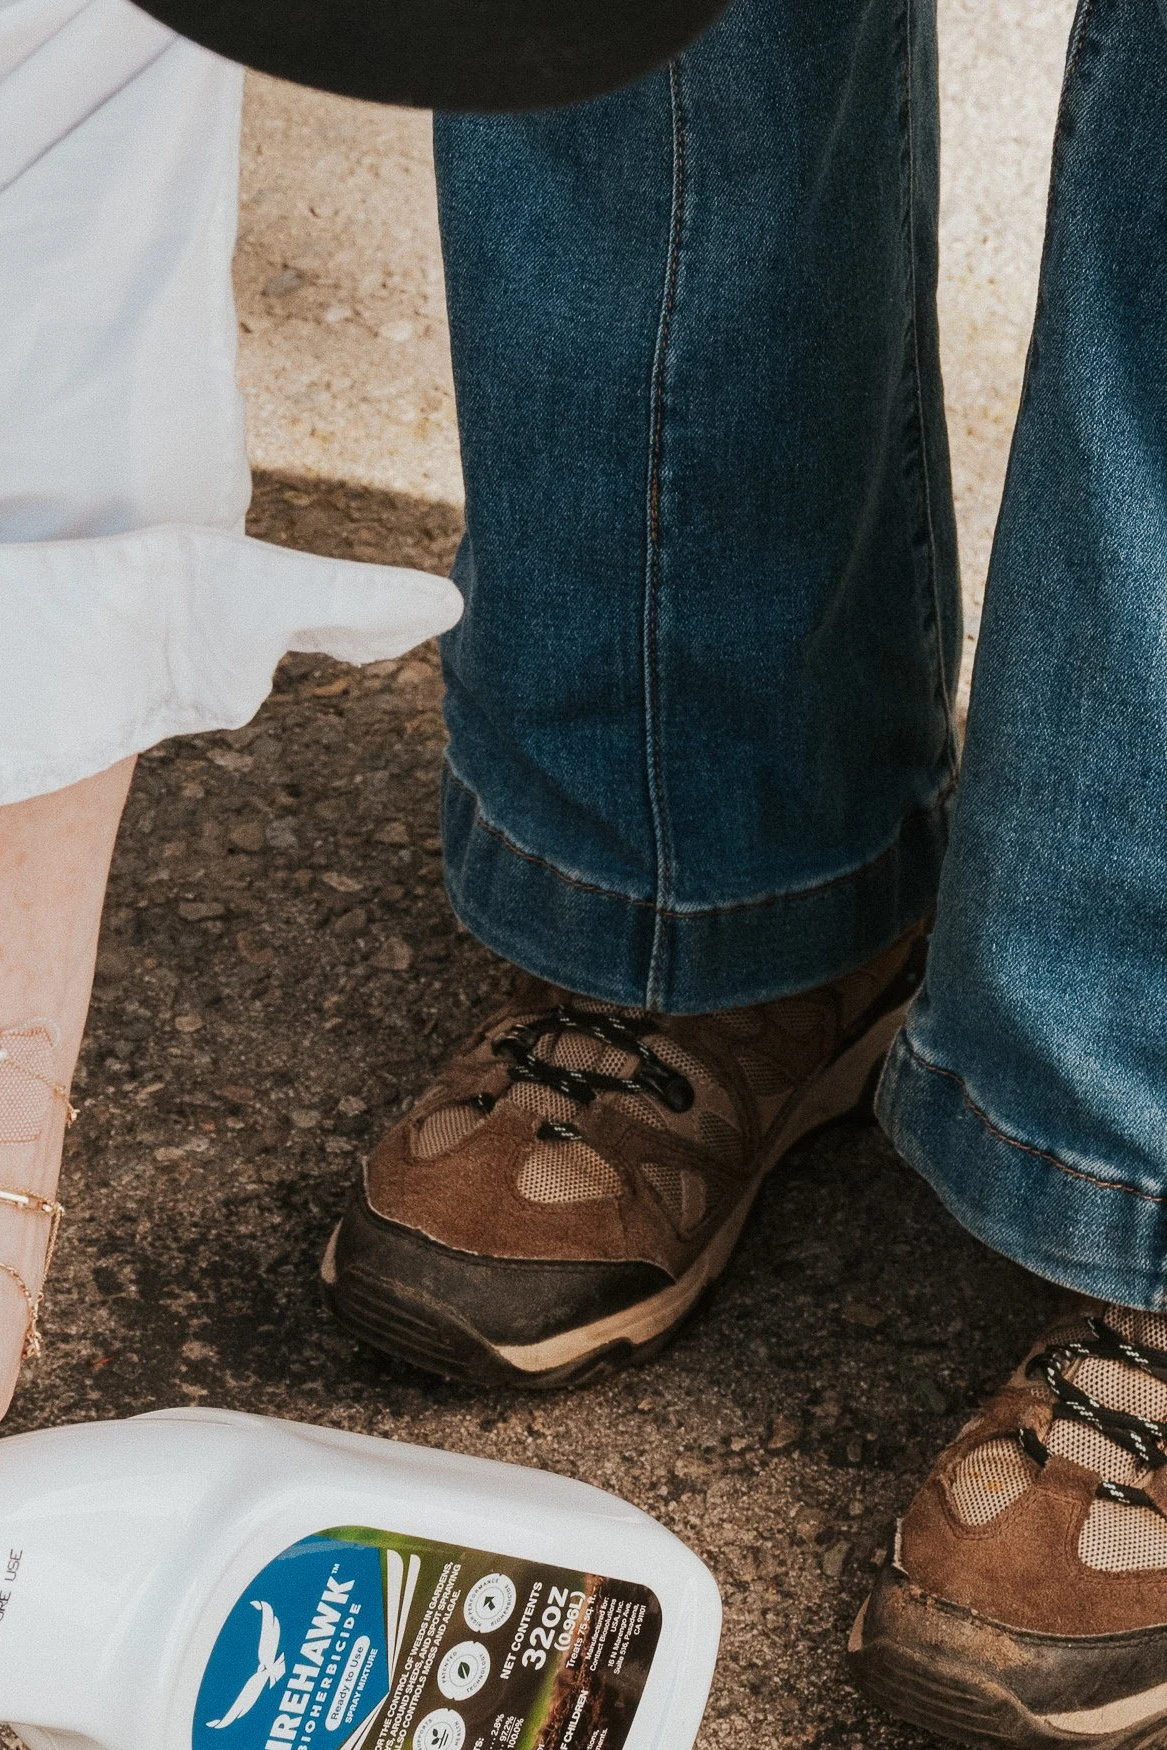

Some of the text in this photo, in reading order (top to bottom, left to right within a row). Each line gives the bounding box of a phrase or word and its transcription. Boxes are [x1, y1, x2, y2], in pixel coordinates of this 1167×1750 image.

[4, 1548, 23, 1582] USE
[428, 1561, 453, 1609] GARDENS,
[423, 1610, 433, 1621] IN
[499, 1581, 544, 1679] NET CONTENTS
[552, 1589, 587, 1652] (0.96L)
[584, 1596, 609, 1659] Manufactured for:
[615, 1600, 625, 1613] Inc.
[632, 1623, 641, 1635] CA
[389, 1694, 410, 1736] AROUND
[405, 1659, 423, 1693] SHEDS,
[418, 1637, 432, 1659] AND
[426, 1610, 442, 1636] SPOT
[436, 1563, 461, 1610] SPRAYING
[409, 1621, 428, 1655] WEEDS
[564, 1593, 596, 1668] Treats 75 sq. ft.
[588, 1598, 617, 1671] Contact Biosolutions
[606, 1658, 615, 1667] 16
[612, 1617, 628, 1650] Marengo
[401, 1675, 427, 1728] CONTROLS
[421, 1646, 438, 1675] MOSS
[432, 1623, 447, 1645] AND
[441, 1588, 461, 1623] ALGAE.
[404, 1656, 415, 1670] OF
[613, 1655, 624, 1674] Suite
[329, 1646, 364, 1720] Ready to Use
[344, 1647, 378, 1723] SPRAY MIXTURE
[386, 1671, 409, 1717] CONTROL
[379, 1718, 392, 1738] THE
[490, 1713, 505, 1736] 2.8%
[499, 1715, 515, 1741] 97.2%
[506, 1717, 524, 1748] 100.0%
[562, 1689, 589, 1743] CHILDREN
